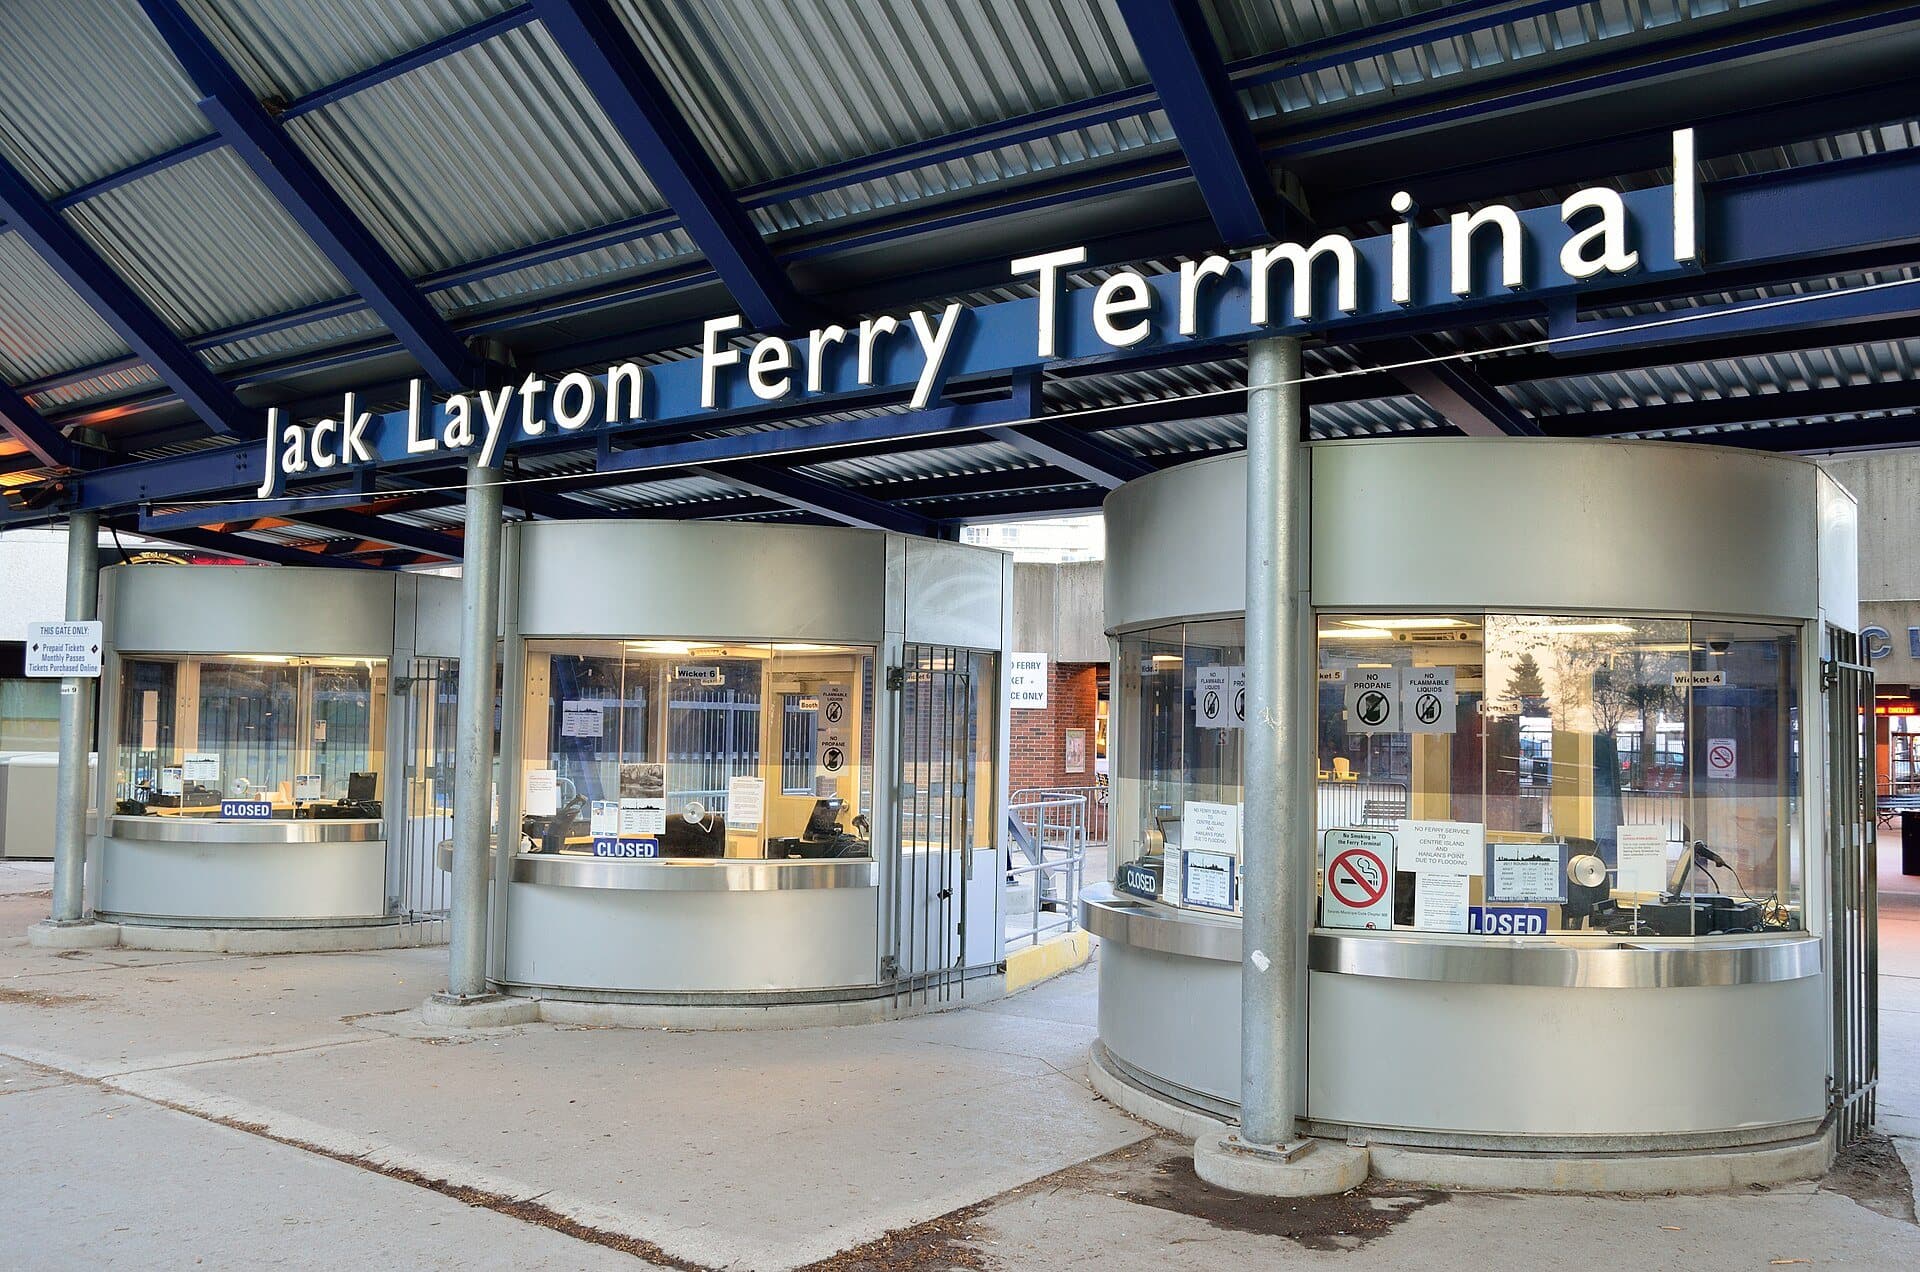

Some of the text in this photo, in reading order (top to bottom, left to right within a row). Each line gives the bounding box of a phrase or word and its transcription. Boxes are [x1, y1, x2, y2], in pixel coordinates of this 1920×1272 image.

[257, 127, 1697, 498] Jack Layton Ferry Terminal
[40, 626, 90, 635] THIS GATE ONLY:
[42, 644, 64, 653] Prepaid
[42, 654, 64, 662] Monthly
[29, 664, 48, 672] Tickets
[1016, 662, 1041, 670] FERRY
[224, 804, 270, 816] CLOSED
[596, 842, 654, 858] CLOSED
[1128, 870, 1156, 892] CLOSED
[1470, 913, 1542, 934] LOSED
